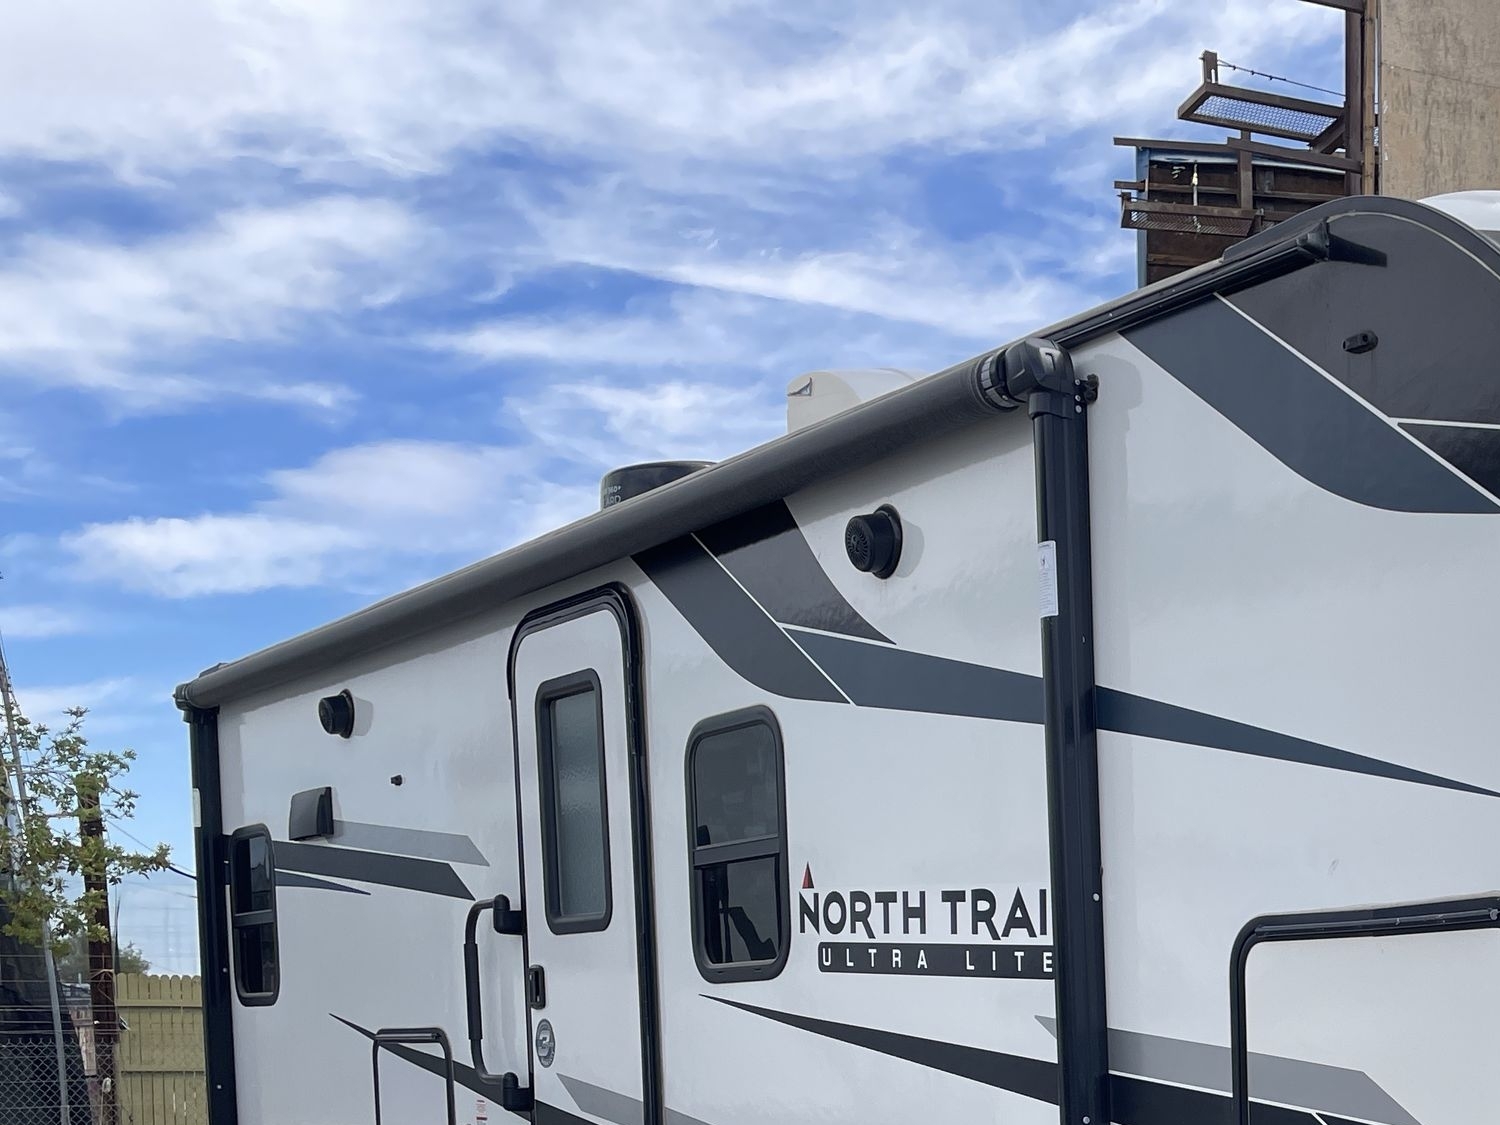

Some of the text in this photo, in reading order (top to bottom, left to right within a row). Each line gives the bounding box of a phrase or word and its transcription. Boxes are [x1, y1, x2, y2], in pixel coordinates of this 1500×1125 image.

[798, 886, 1048, 941] NORTH TRAI
[822, 947, 1053, 973] ULTRA LITE
